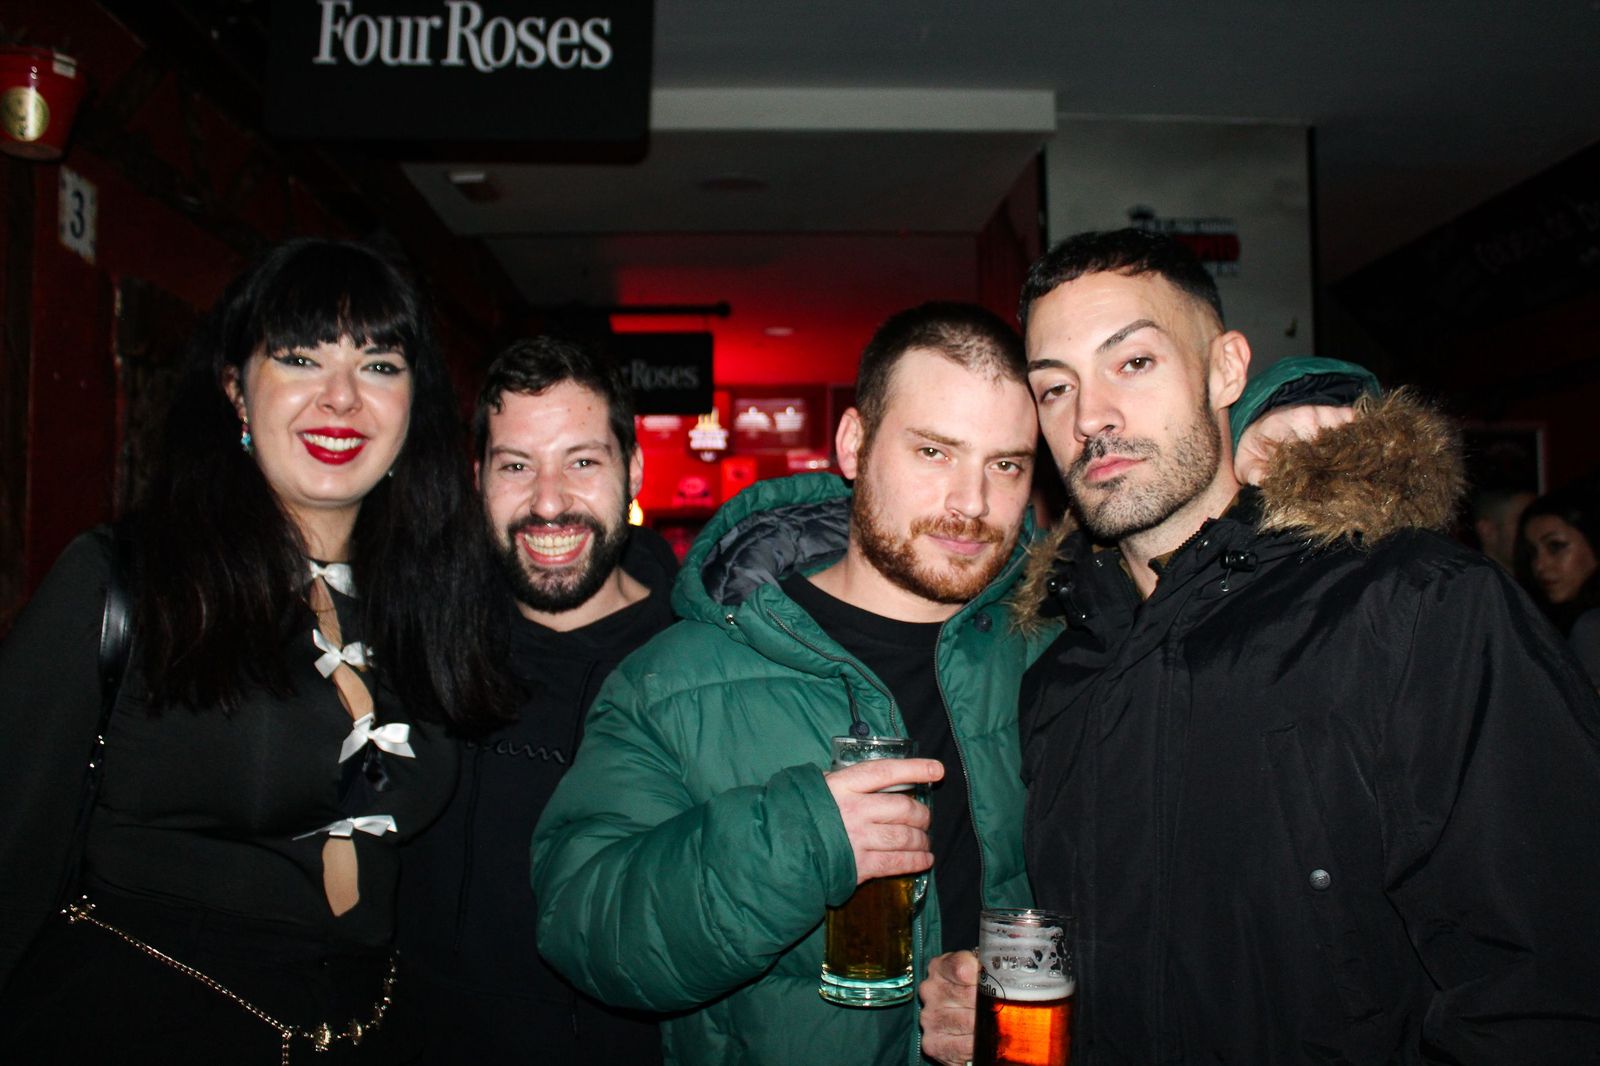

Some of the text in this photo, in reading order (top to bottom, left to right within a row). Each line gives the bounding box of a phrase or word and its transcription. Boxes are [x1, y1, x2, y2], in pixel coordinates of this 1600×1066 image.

[312, 0, 614, 74] Four Roses
[70, 190, 85, 239] 3
[631, 359, 699, 392] Roses
